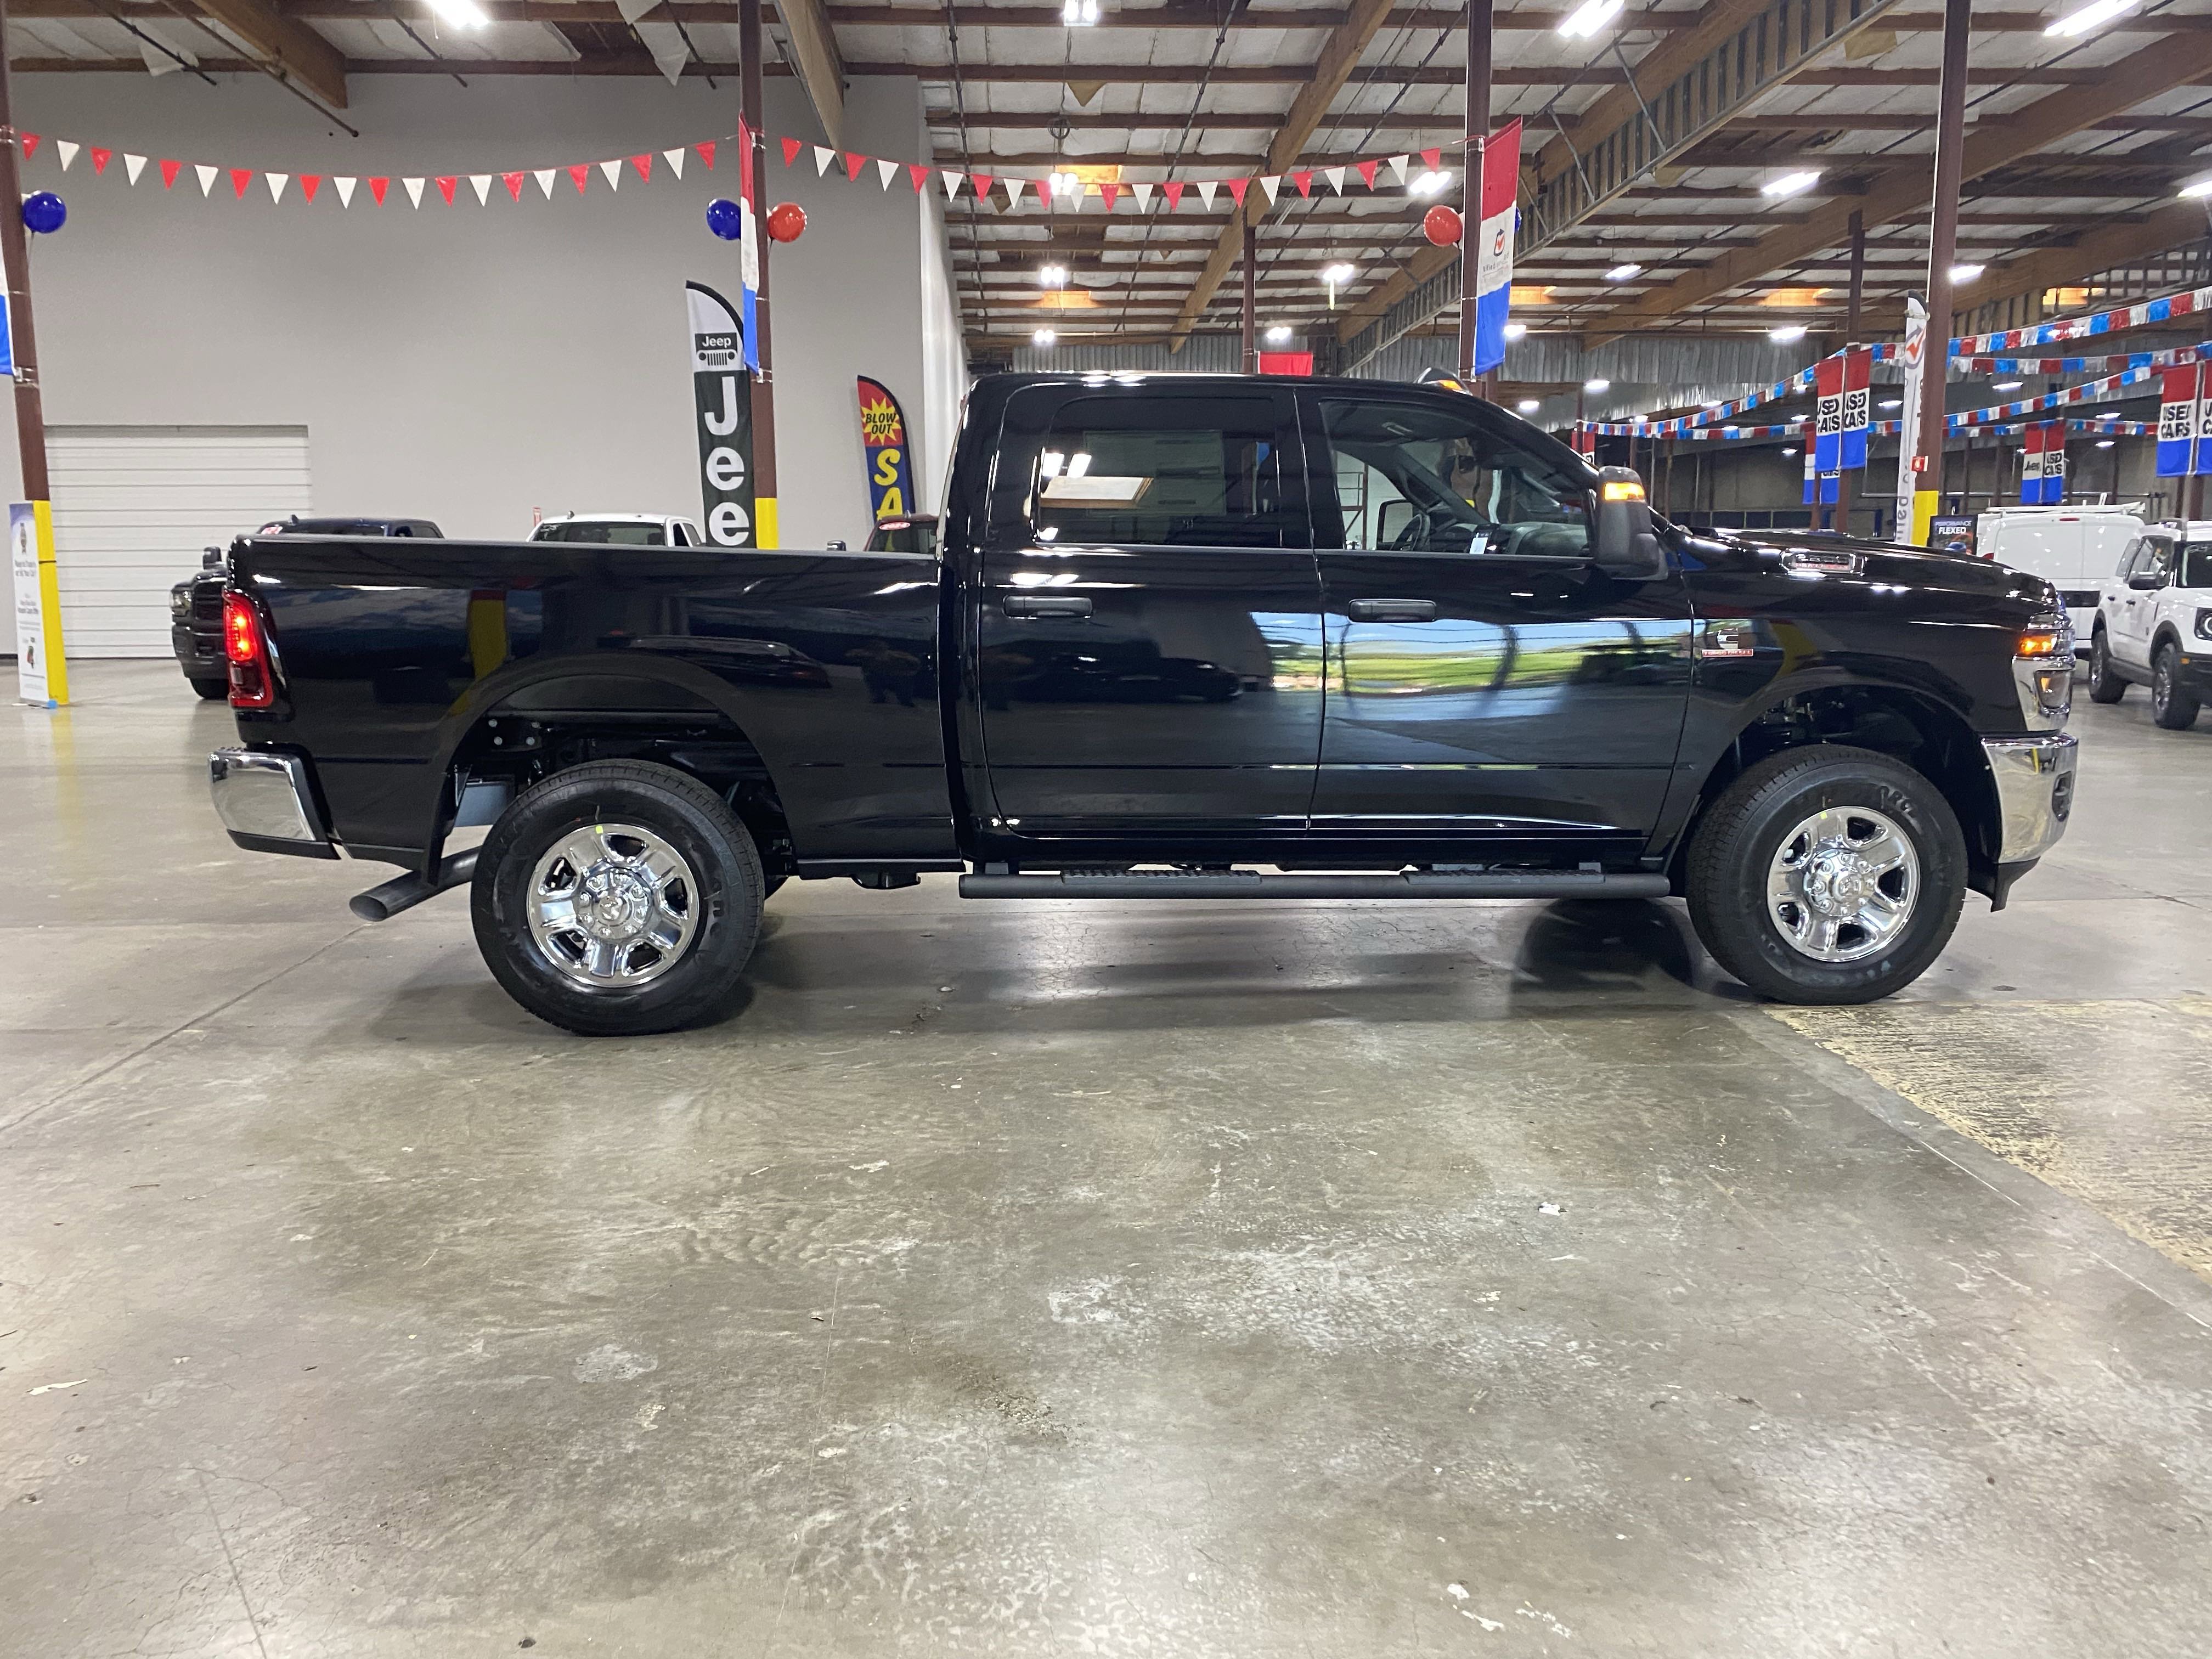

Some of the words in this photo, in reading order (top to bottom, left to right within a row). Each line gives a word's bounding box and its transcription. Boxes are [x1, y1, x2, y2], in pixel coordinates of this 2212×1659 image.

[702, 336, 732, 349] Jeep
[1846, 392, 1866, 410] SD
[866, 413, 896, 424] BLOW
[1844, 409, 1866, 428] CAS
[871, 424, 893, 435] OUT
[704, 376, 750, 546] Jee
[873, 448, 904, 521] SA
[1938, 526, 1967, 534] FLEXED
